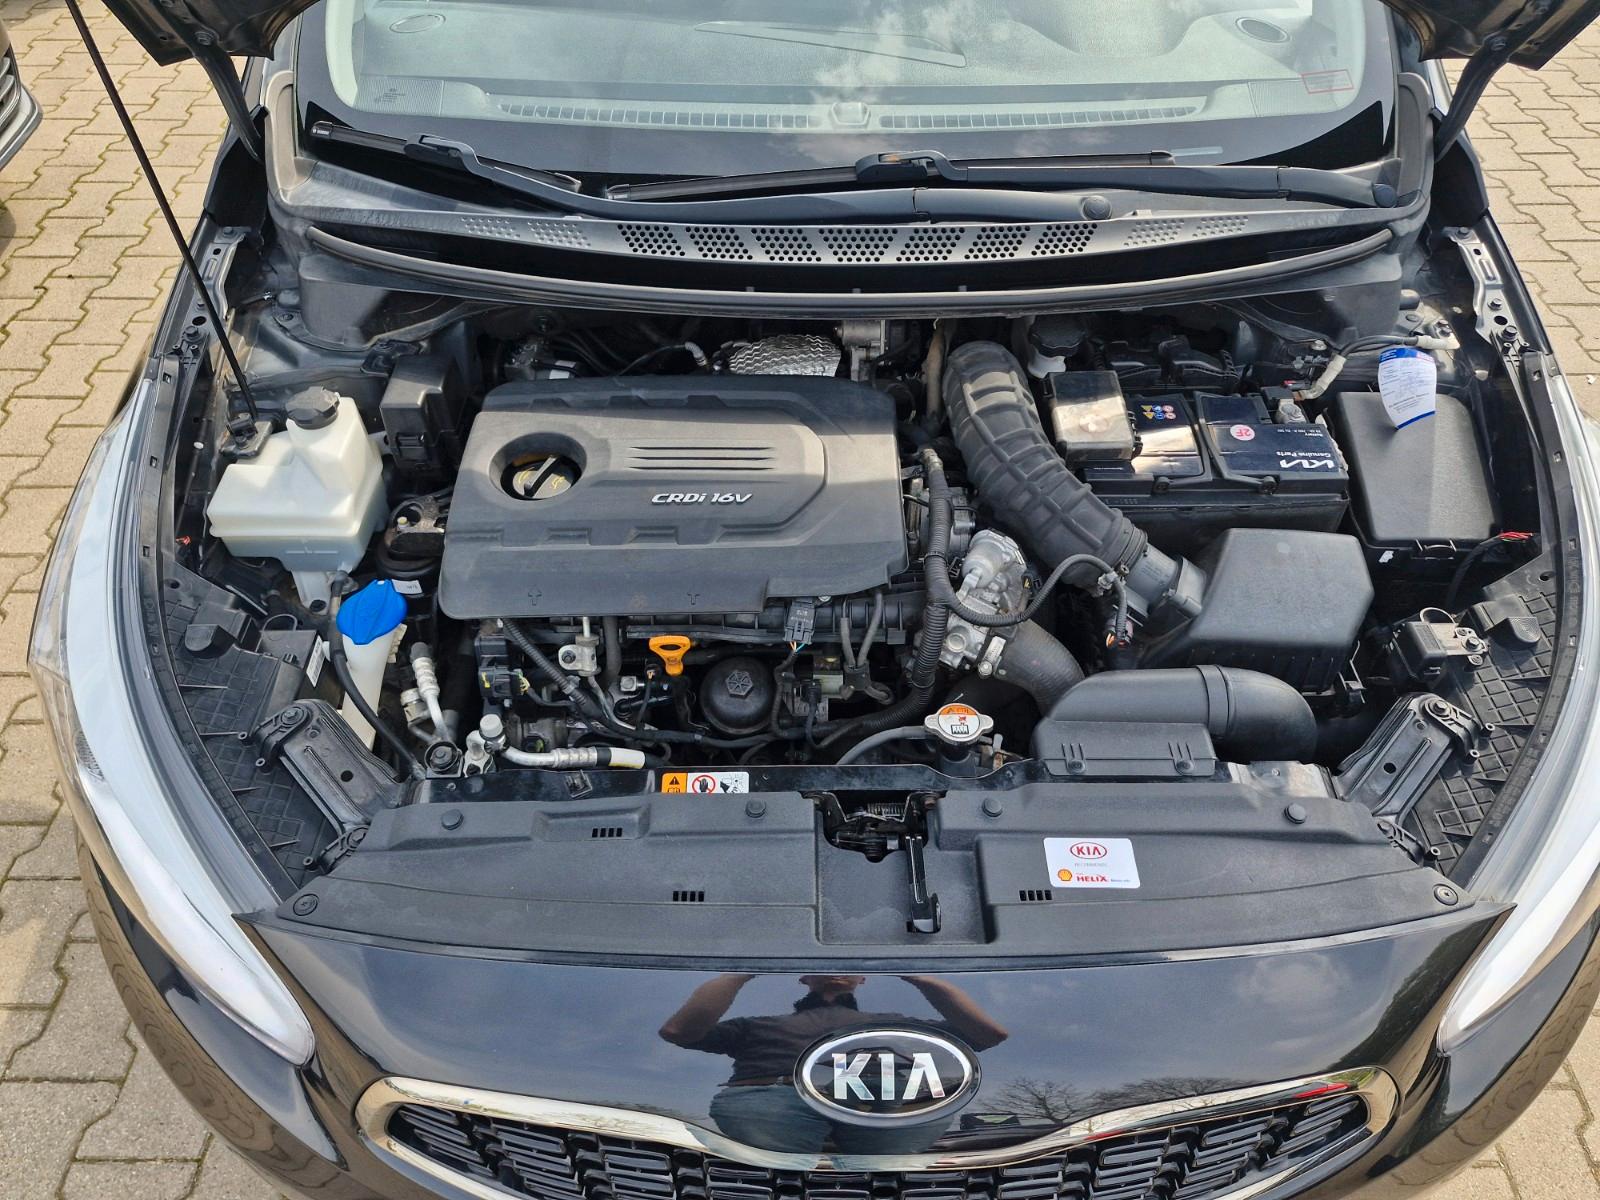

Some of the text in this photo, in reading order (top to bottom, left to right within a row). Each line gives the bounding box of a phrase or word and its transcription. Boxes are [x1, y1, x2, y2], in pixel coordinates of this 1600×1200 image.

[1235, 428, 1252, 437] 2F
[651, 493, 753, 503] CRDi 16V
[1076, 846, 1102, 856] KIA
[831, 1052, 946, 1101] KIA
